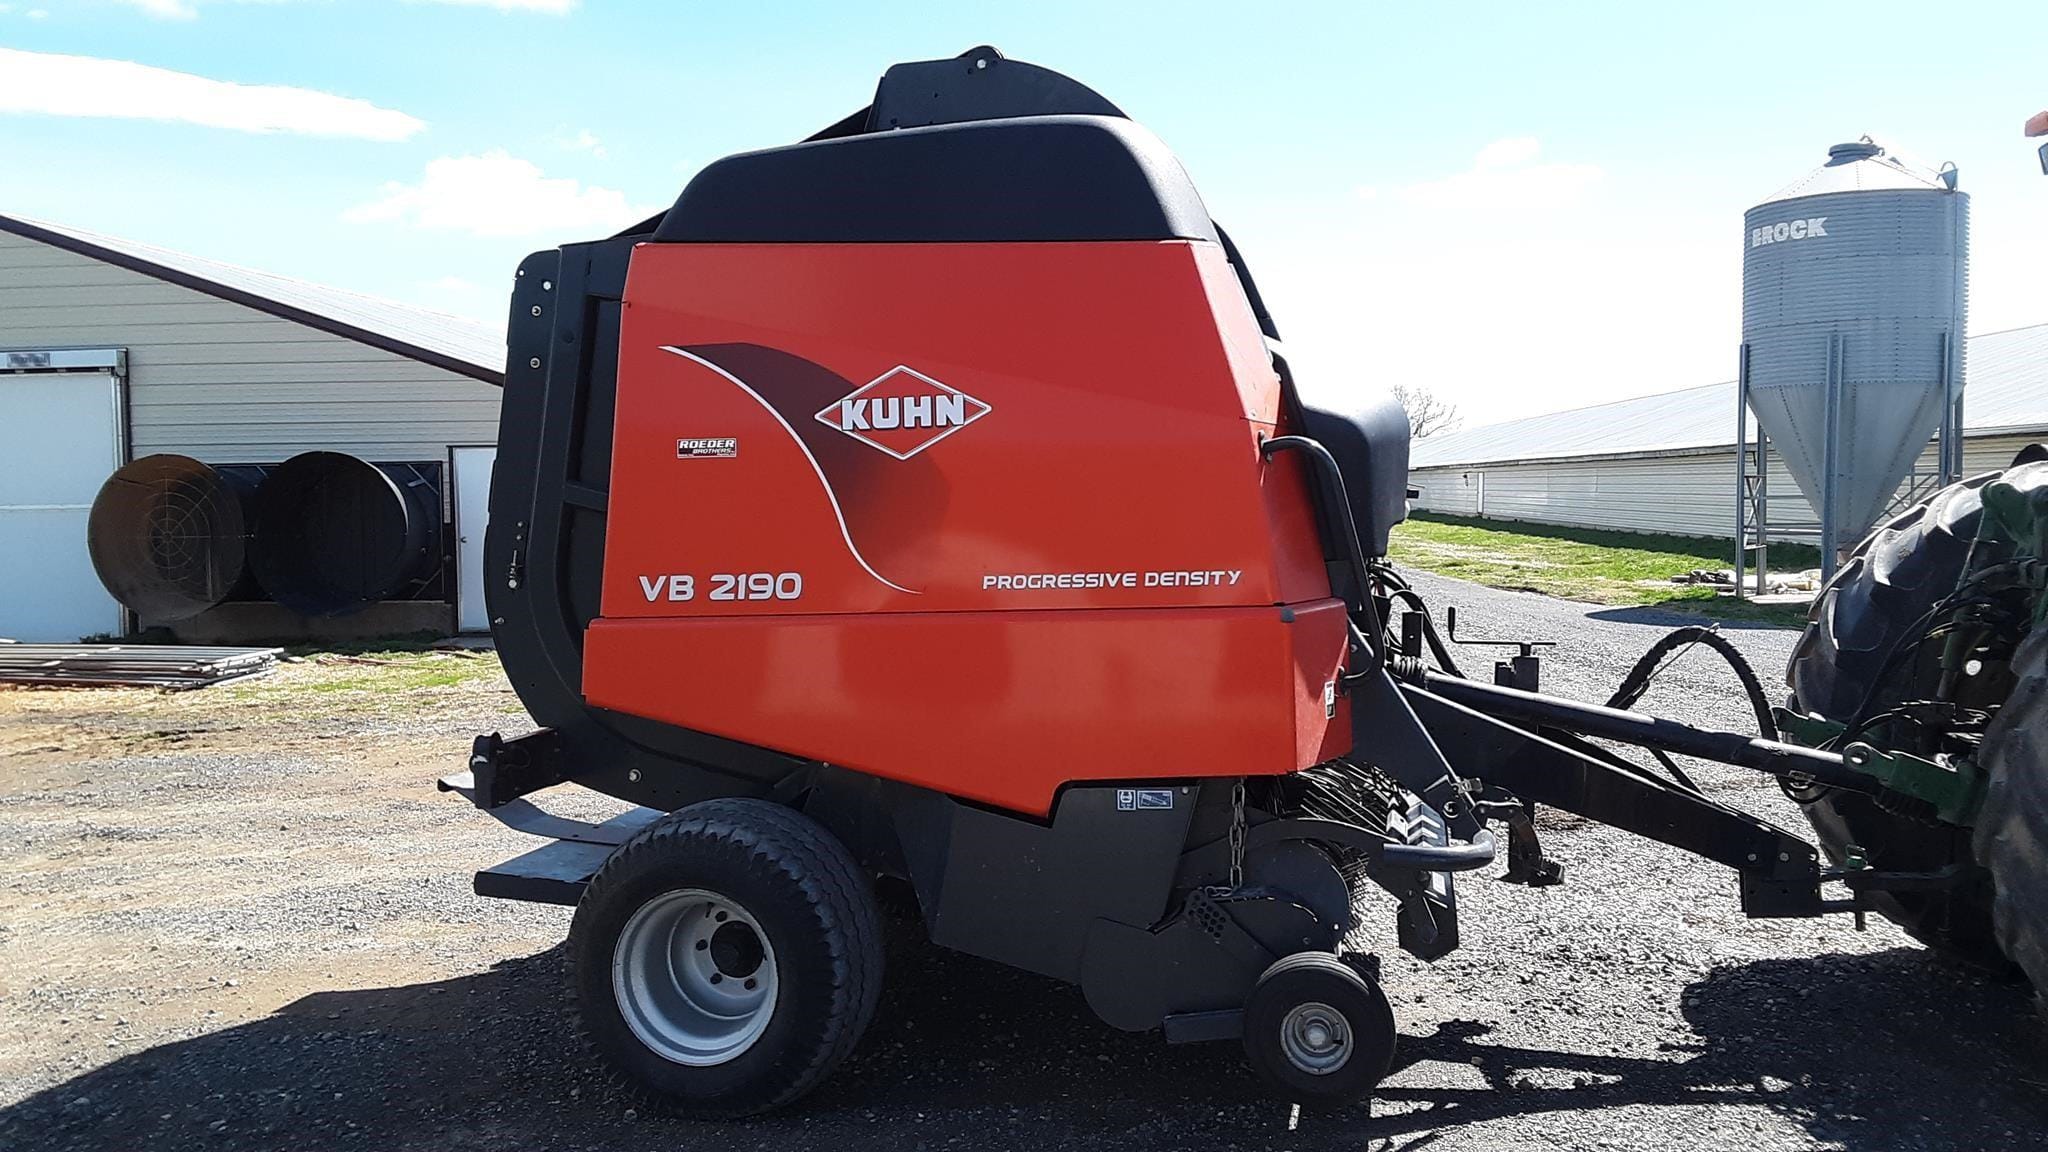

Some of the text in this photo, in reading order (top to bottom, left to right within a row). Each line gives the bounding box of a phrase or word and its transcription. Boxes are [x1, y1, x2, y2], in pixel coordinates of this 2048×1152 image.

[1752, 217, 1829, 247] BROCK
[841, 394, 965, 431] KUHN
[679, 440, 735, 449] ROEDER
[638, 572, 802, 602] VB 2190
[982, 570, 1242, 590] PROGRESSIVE DENSITY
